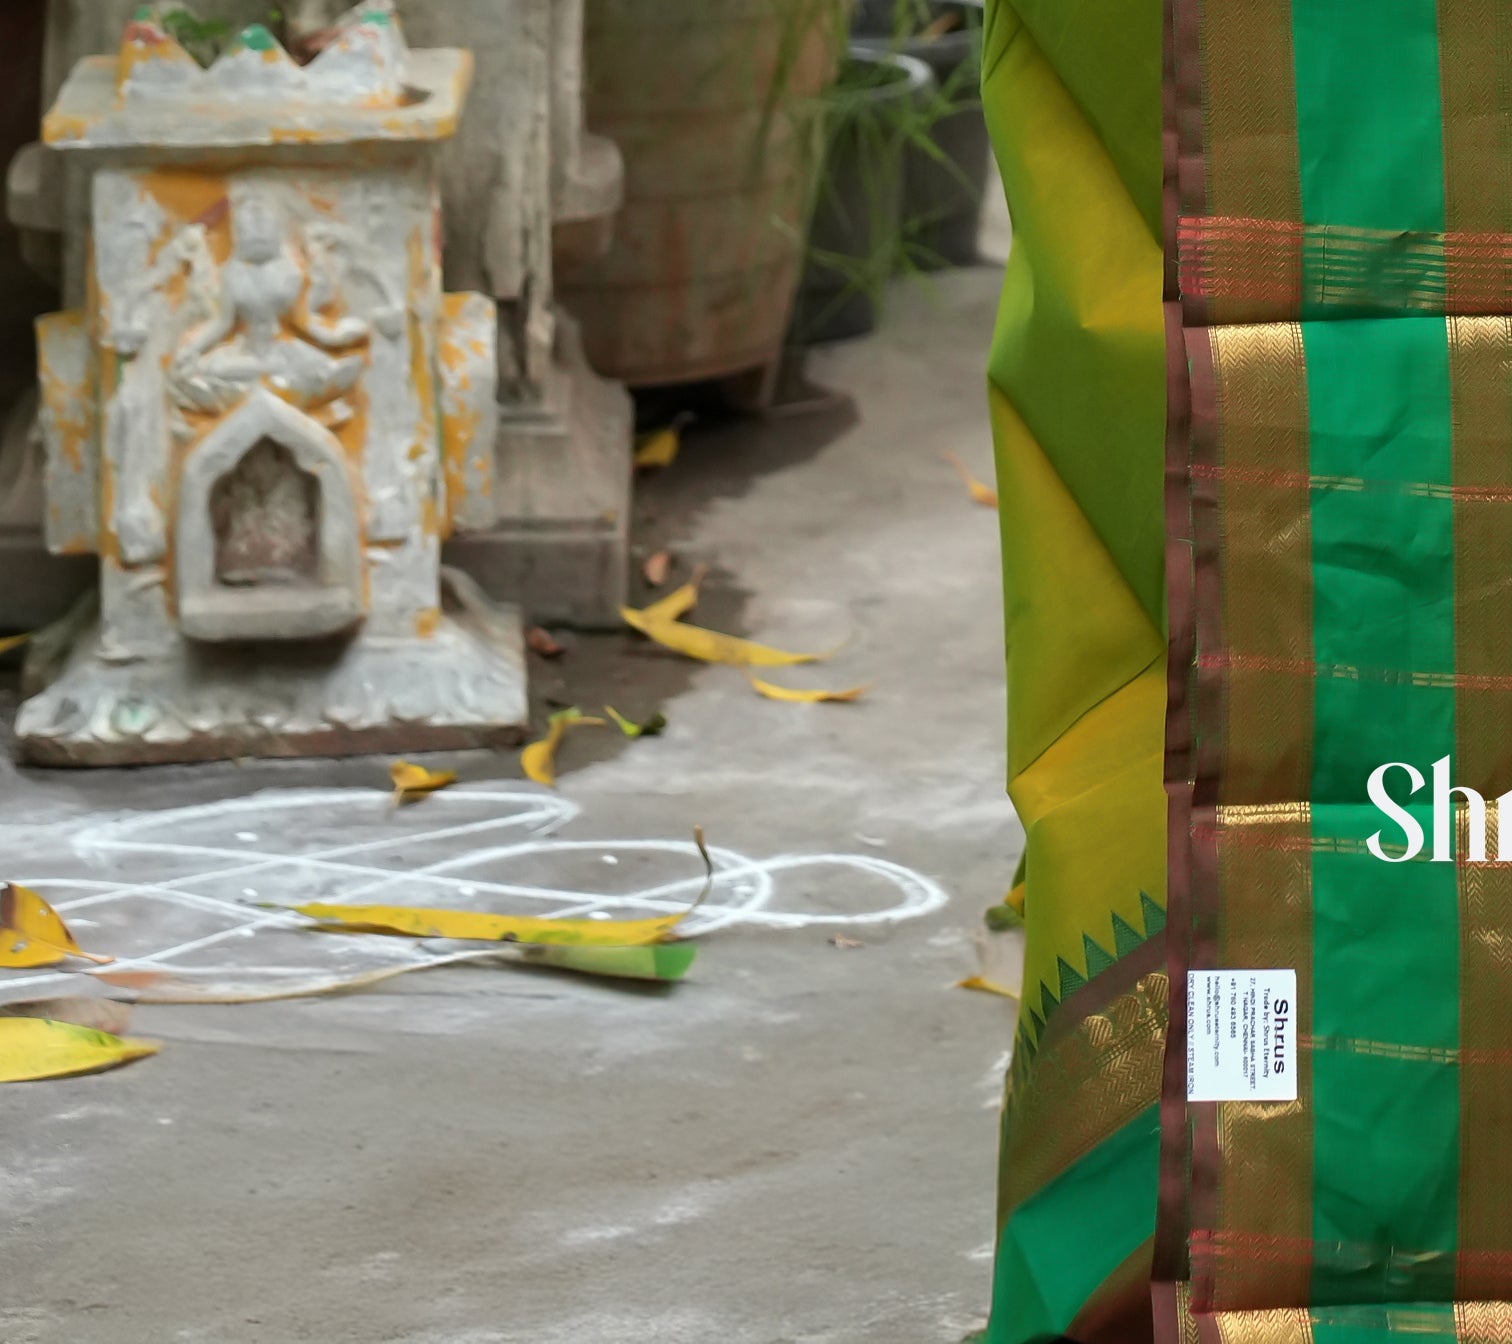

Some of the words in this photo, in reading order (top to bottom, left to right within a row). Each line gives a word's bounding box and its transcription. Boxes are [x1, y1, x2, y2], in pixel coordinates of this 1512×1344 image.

[1262, 1012, 1270, 1023] by:
[1274, 999, 1288, 1074] Shrus
[1262, 1048, 1270, 1078] Eternity
